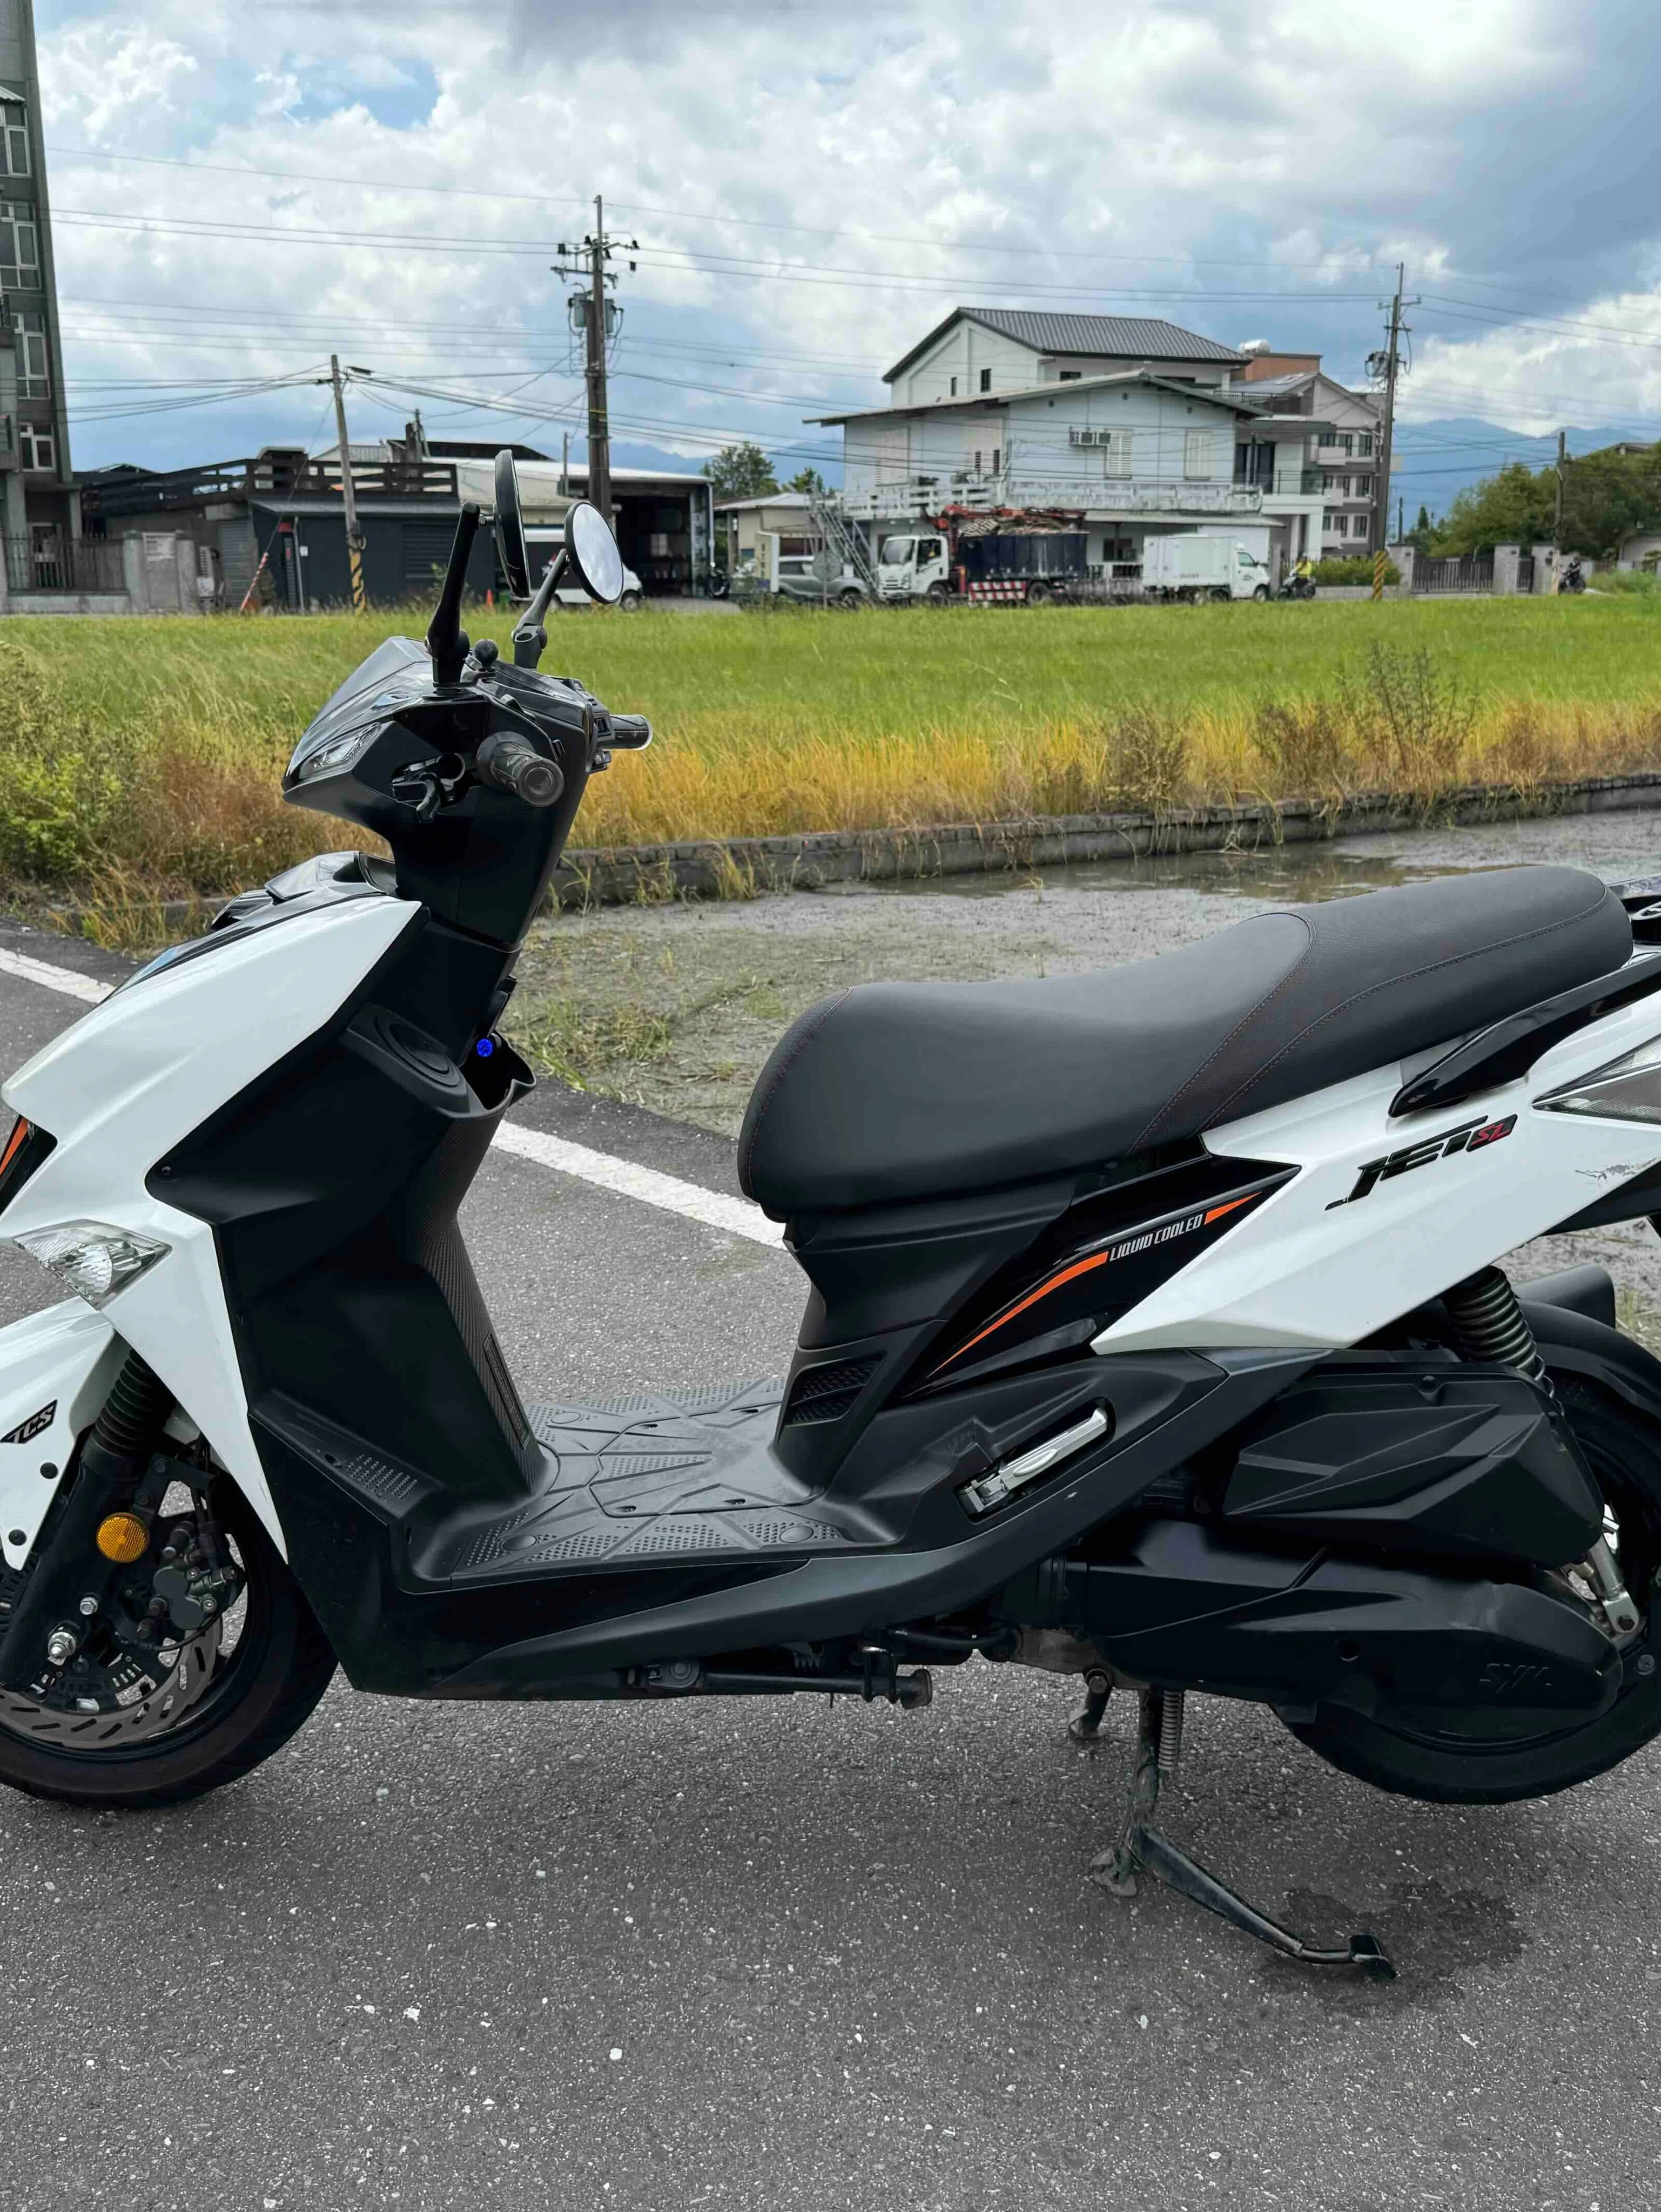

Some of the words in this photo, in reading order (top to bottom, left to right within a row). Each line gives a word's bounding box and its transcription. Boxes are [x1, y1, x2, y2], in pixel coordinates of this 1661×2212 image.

[1109, 1233, 1154, 1262] LIQUID
[1154, 1213, 1203, 1245] COOLED
[7, 1405, 55, 1444] TCS
